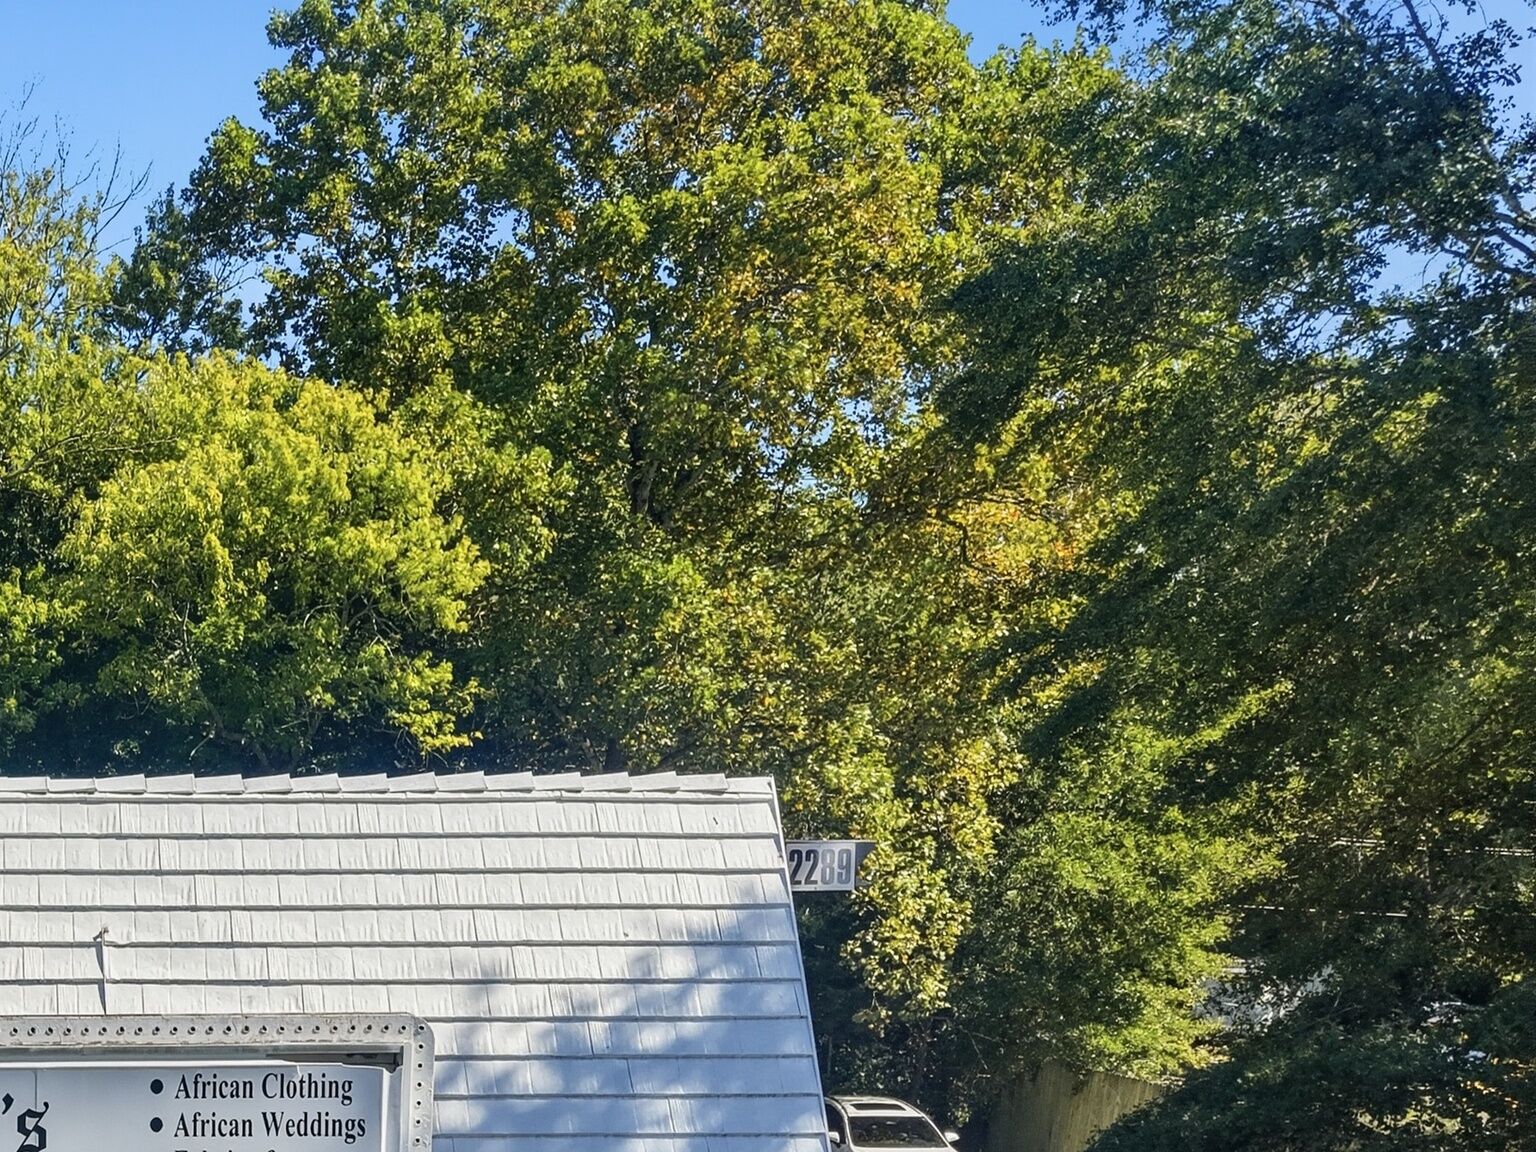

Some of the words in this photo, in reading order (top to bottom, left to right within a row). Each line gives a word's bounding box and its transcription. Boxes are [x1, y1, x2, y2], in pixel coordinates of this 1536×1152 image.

[789, 848, 852, 886] 2289
[175, 1073, 254, 1099] African
[261, 1073, 353, 1106] Clothing
[174, 1112, 253, 1137] African
[261, 1112, 366, 1144] Weddings
